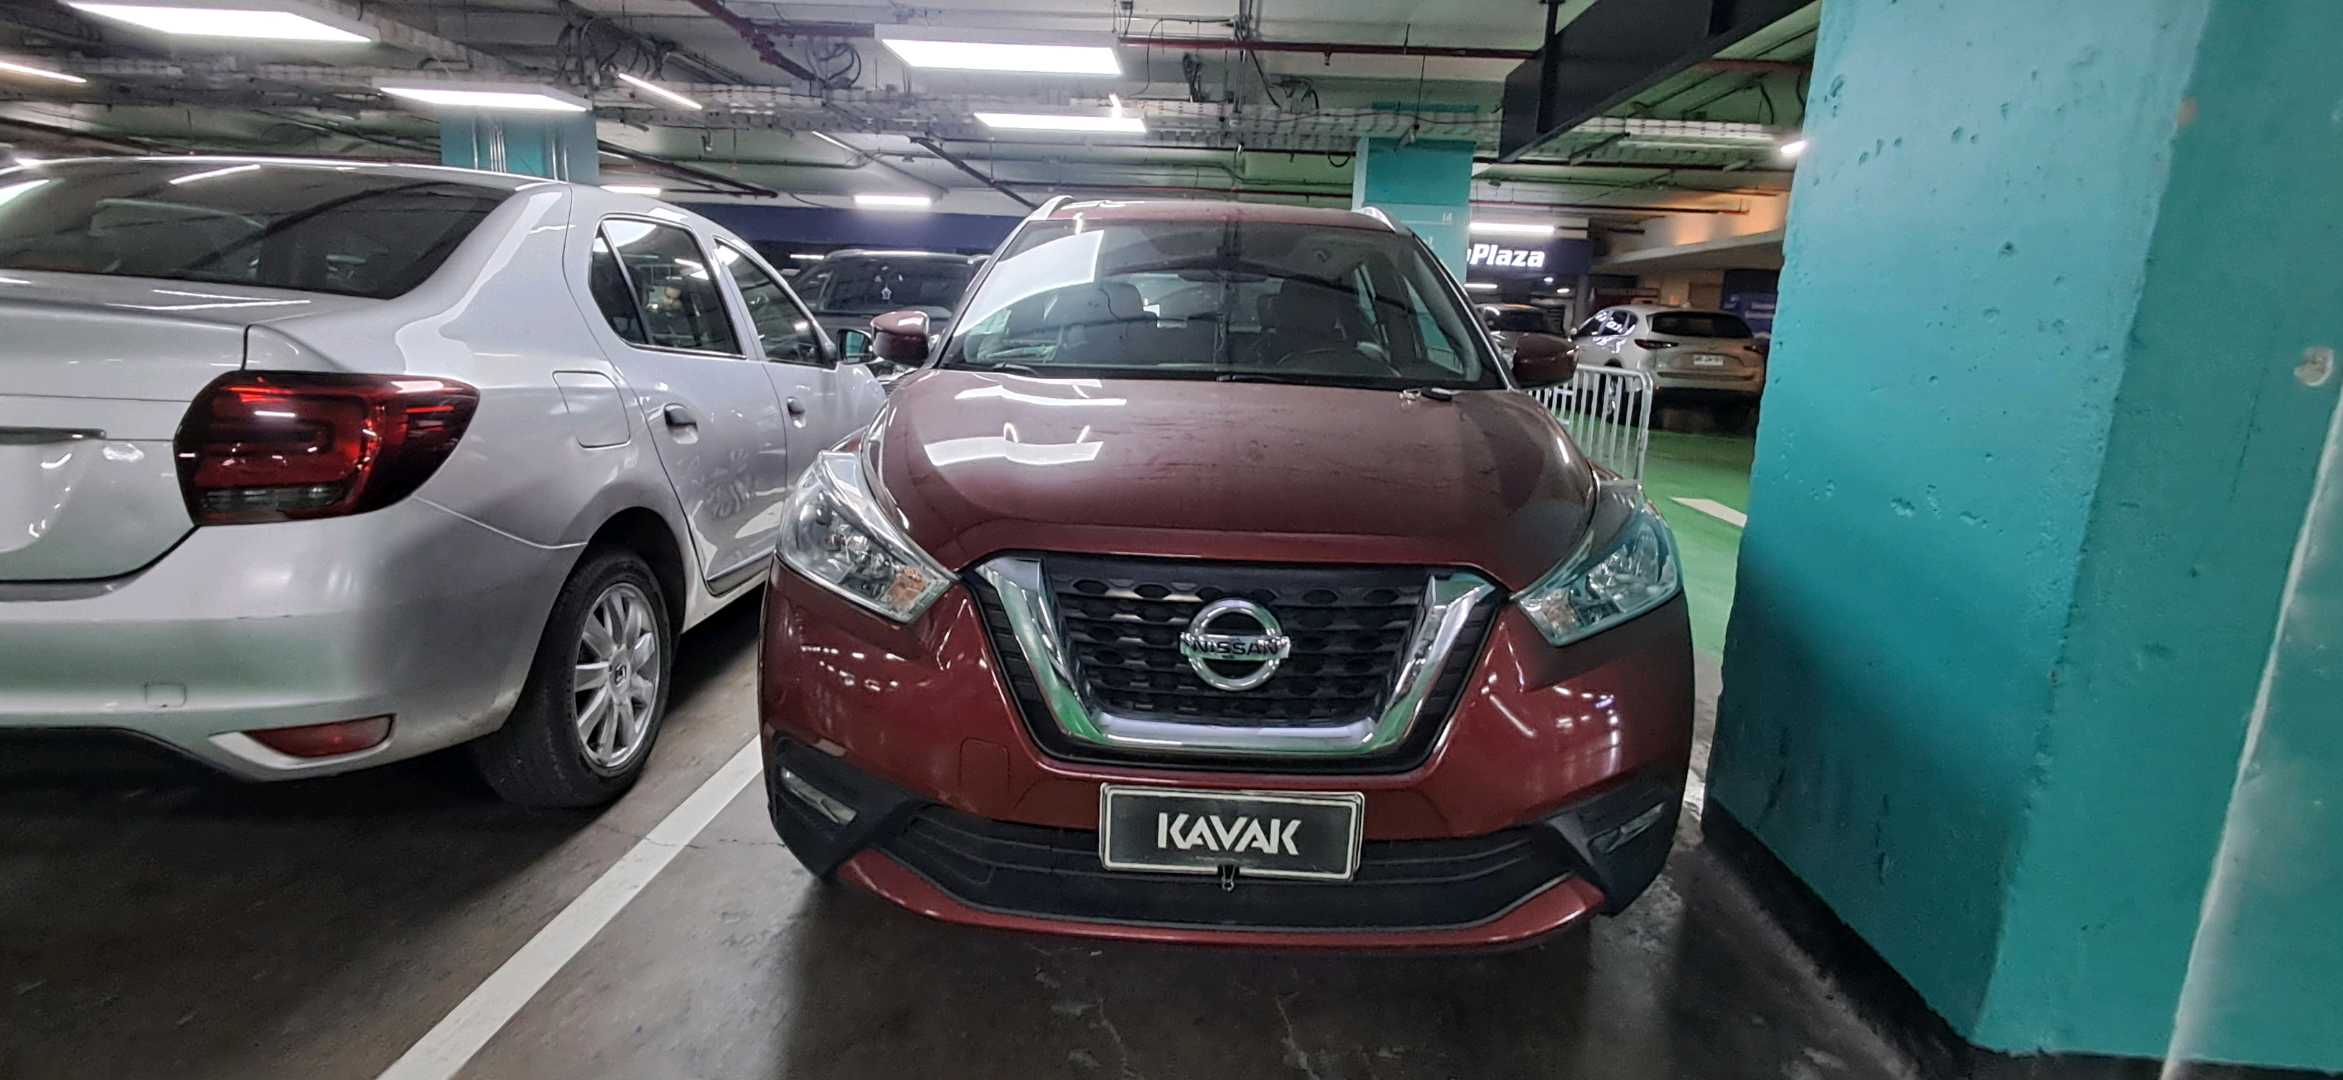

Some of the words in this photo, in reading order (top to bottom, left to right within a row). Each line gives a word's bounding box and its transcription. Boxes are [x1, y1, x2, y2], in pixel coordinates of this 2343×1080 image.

[1466, 243, 1545, 267] Plaza
[1192, 640, 1279, 655] NISSAN
[1157, 812, 1301, 856] KAVAK
